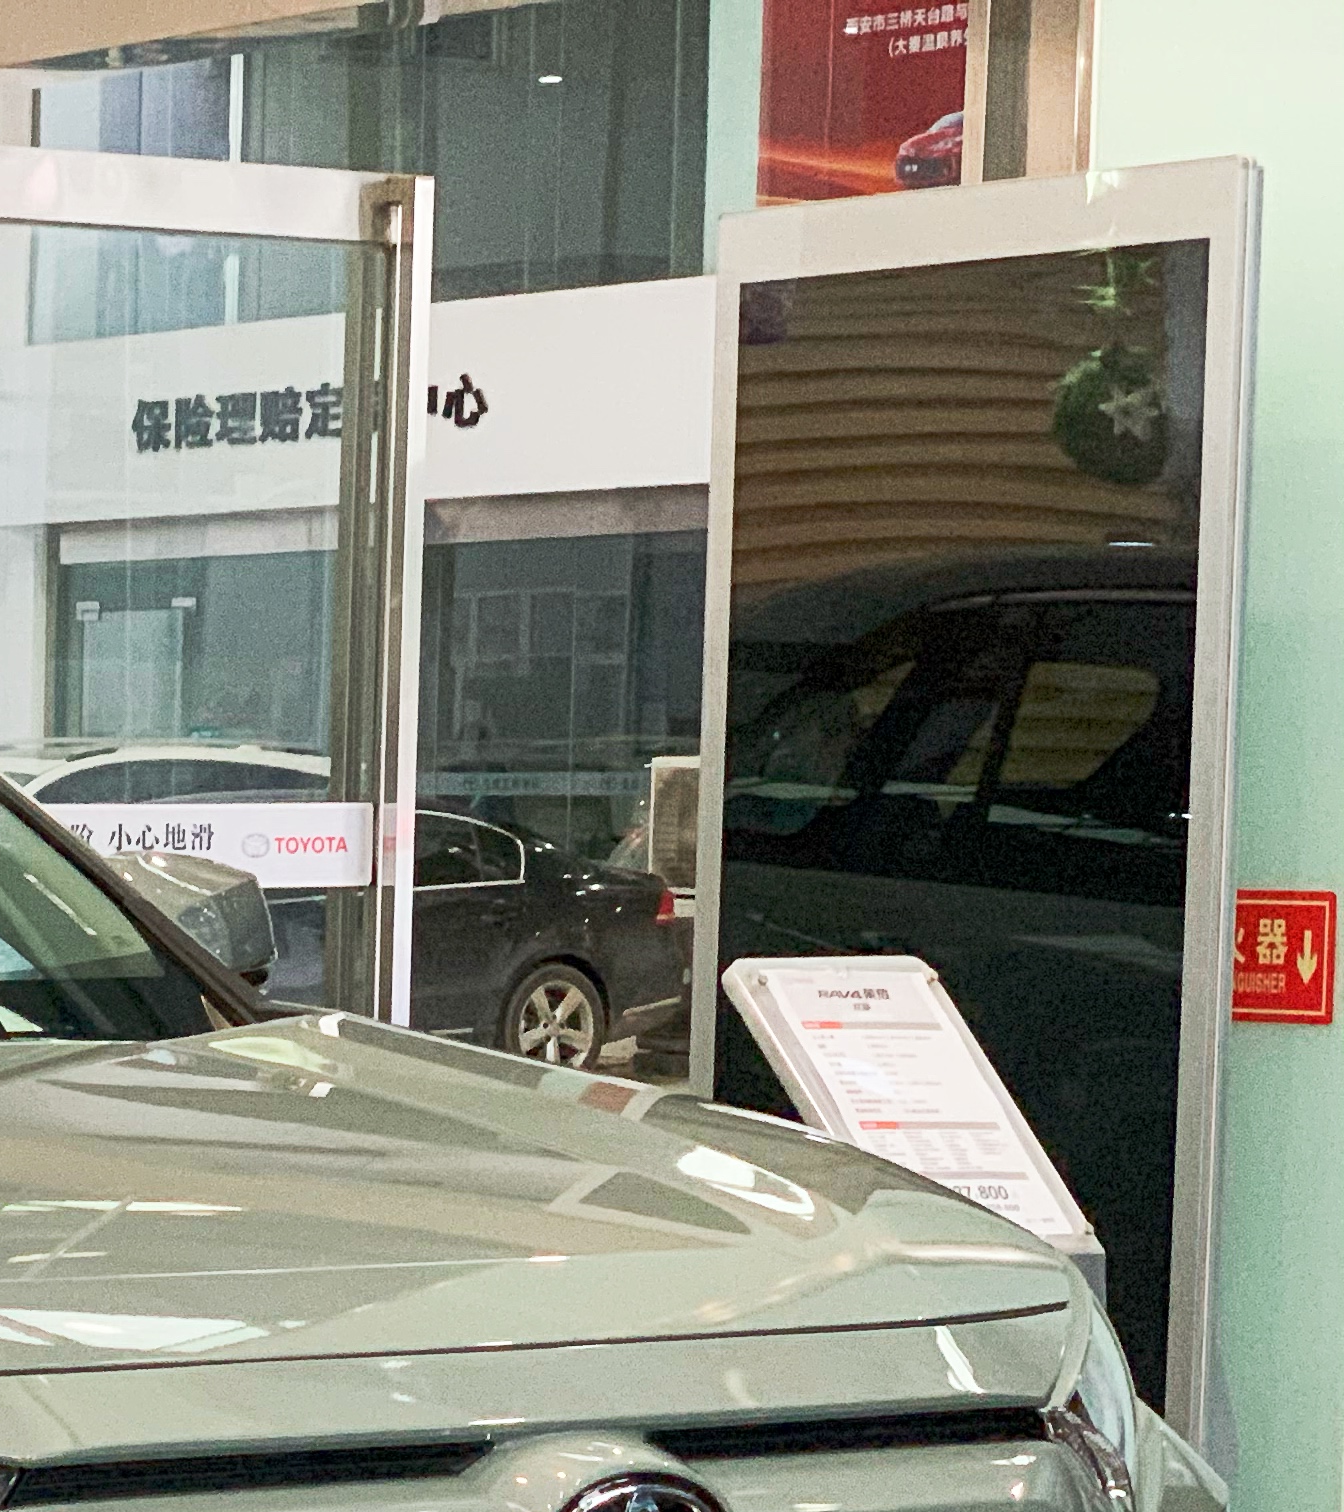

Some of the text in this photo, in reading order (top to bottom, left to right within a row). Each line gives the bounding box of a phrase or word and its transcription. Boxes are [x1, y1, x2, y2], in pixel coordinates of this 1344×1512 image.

[131, 373, 489, 453] 保险理赔定心
[108, 822, 215, 852] 小心地滑
[274, 835, 349, 855] TOYOTA
[1232, 972, 1287, 994] GUISHER
